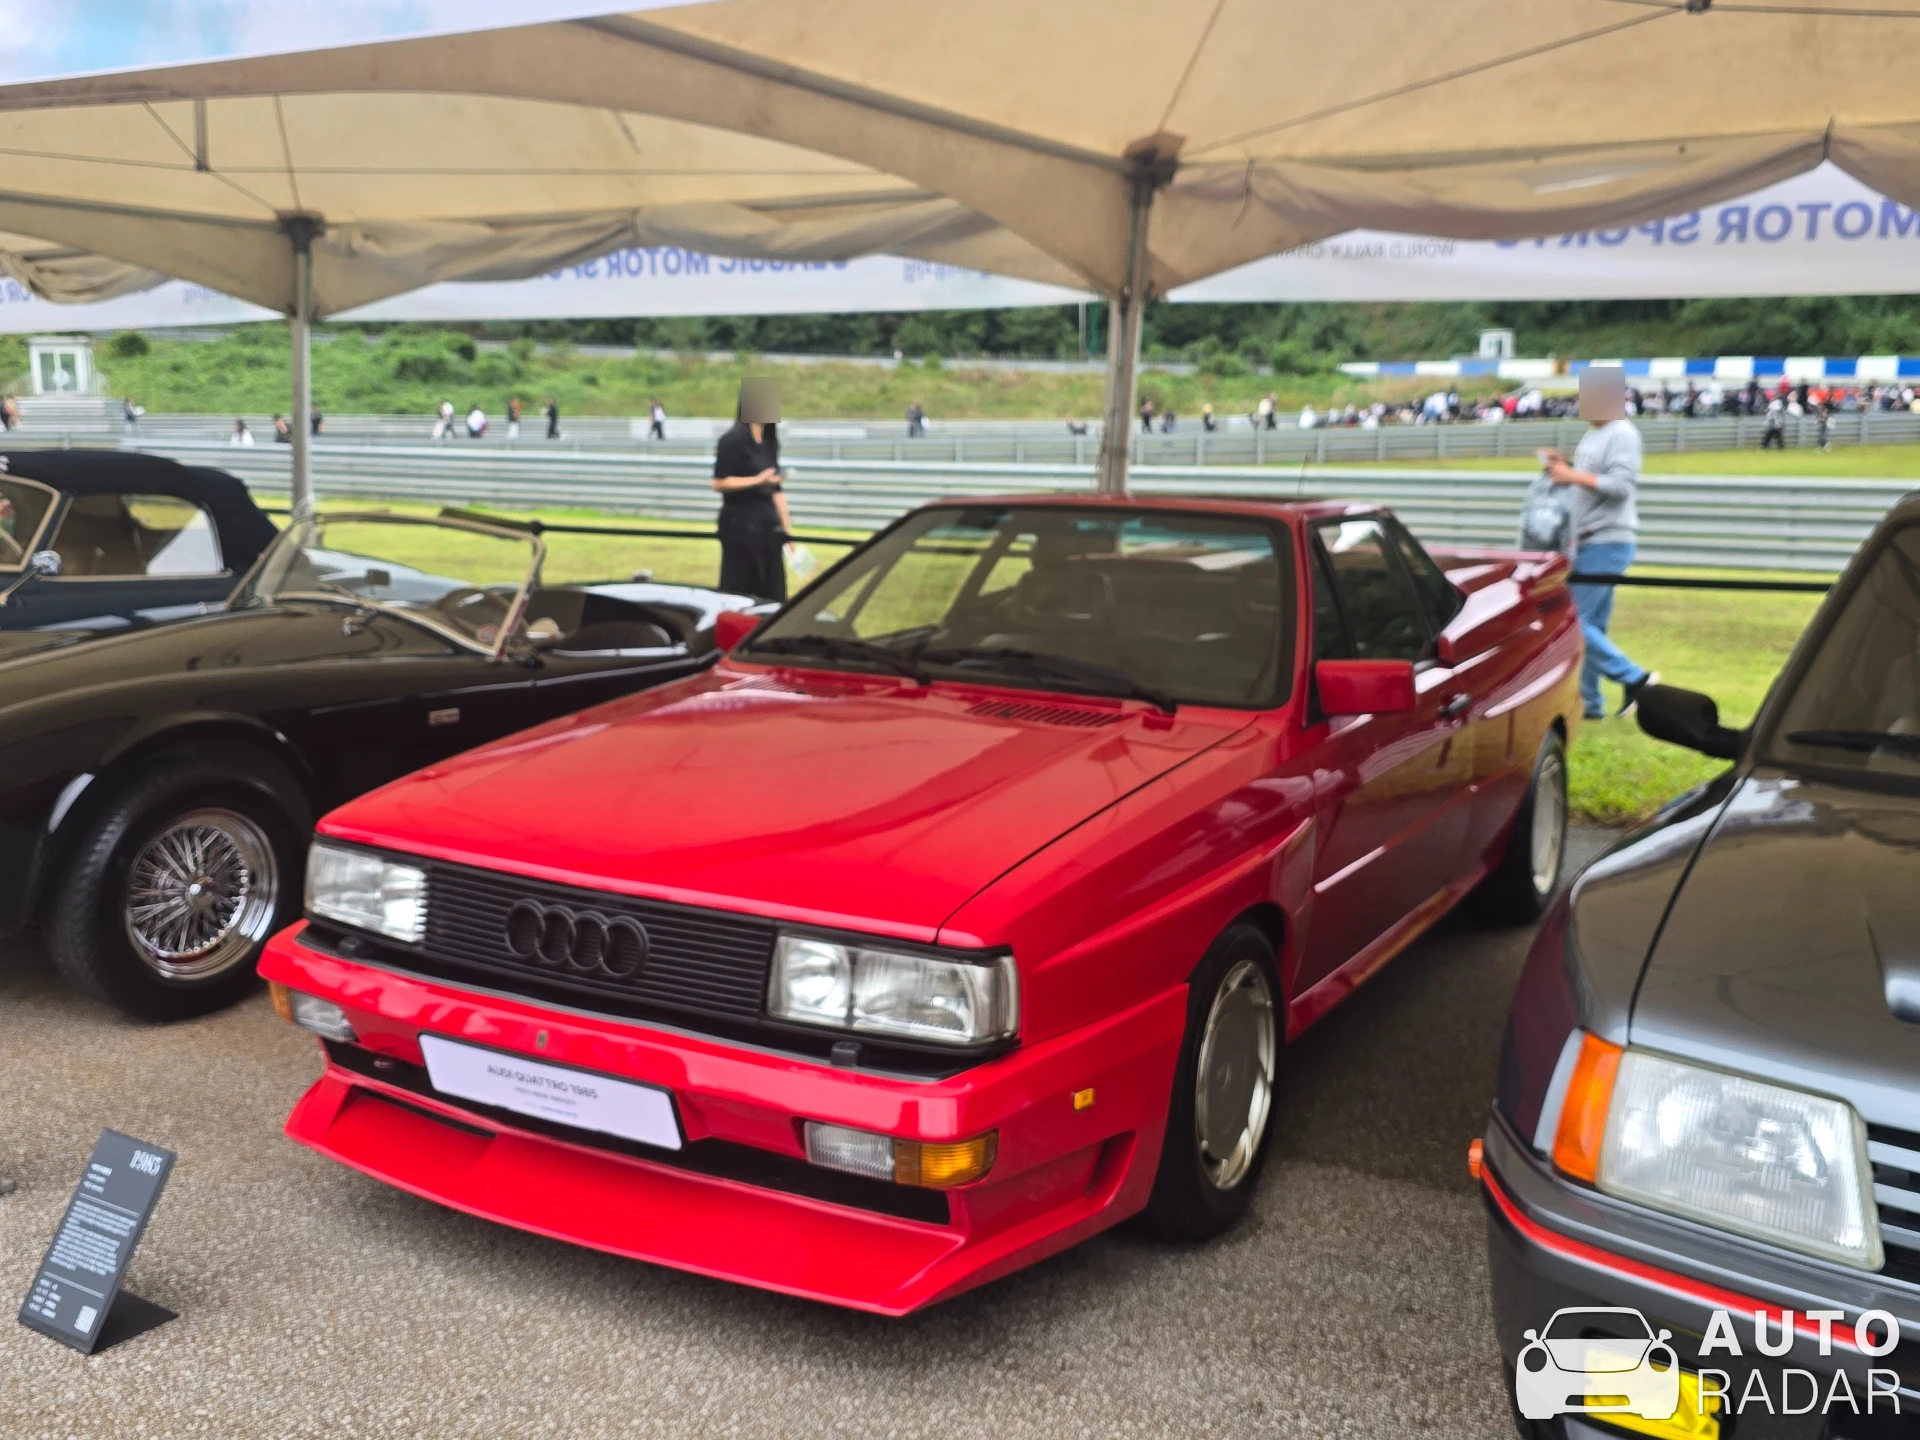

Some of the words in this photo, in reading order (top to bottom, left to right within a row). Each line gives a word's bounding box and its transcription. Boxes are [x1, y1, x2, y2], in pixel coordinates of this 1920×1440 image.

[488, 1065, 513, 1079] AUDI
[515, 1072, 569, 1092] QUATTRO
[129, 1150, 164, 1176] 1985
